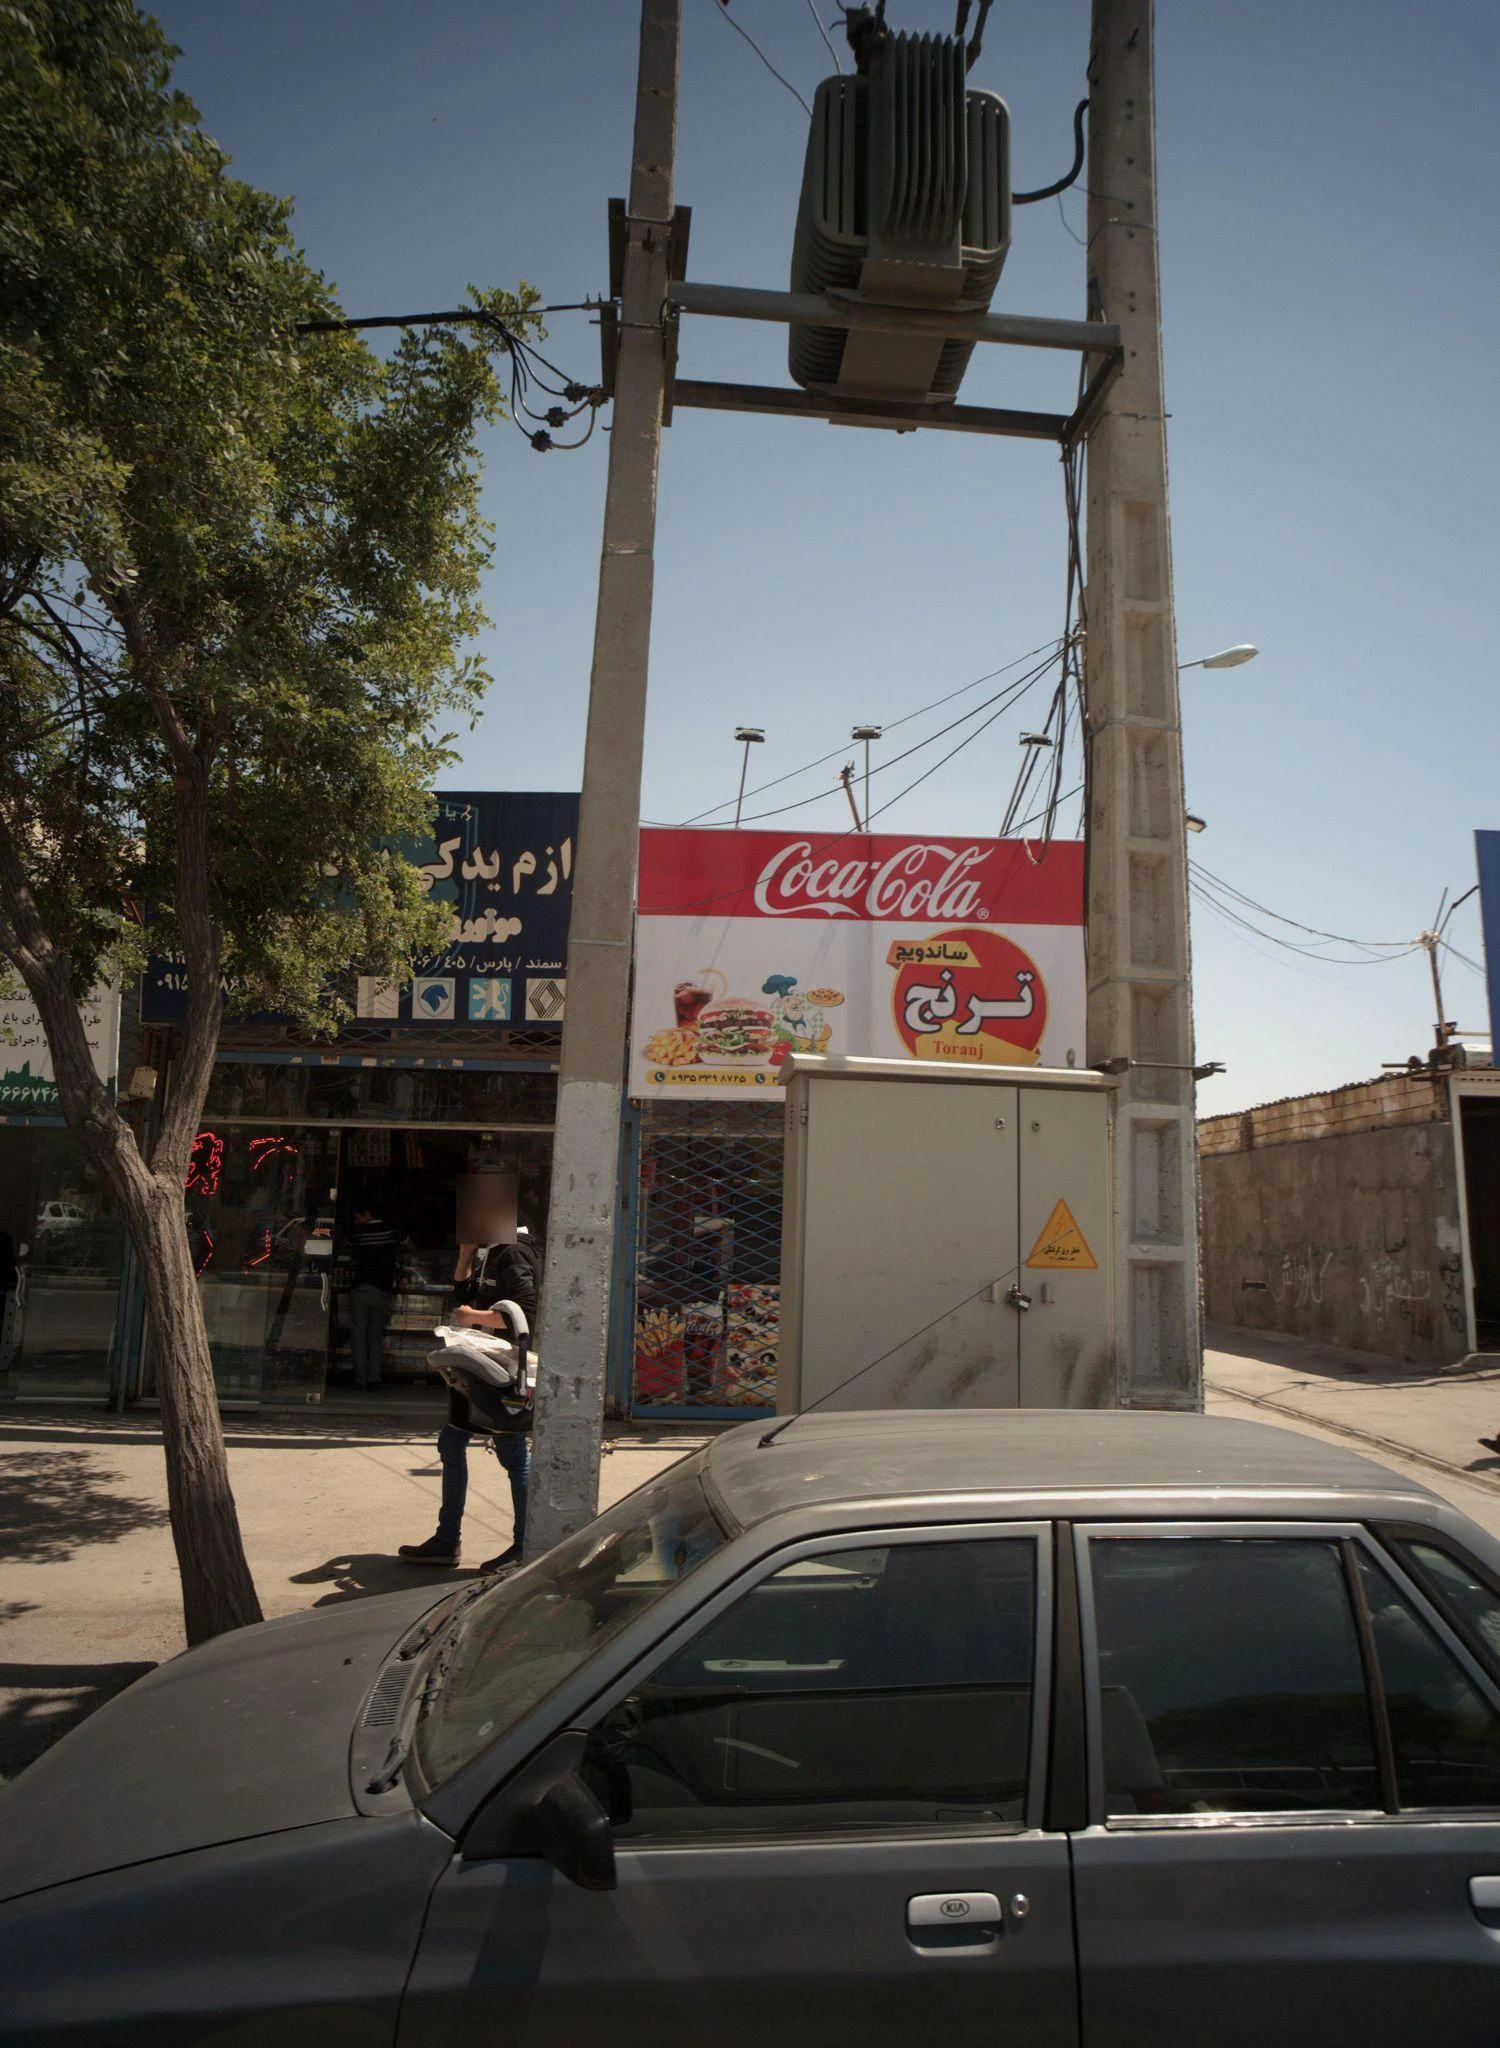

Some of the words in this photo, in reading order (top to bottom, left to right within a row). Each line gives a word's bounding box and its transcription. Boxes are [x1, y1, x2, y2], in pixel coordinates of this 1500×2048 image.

[754, 841, 995, 918] Coca-Cola
[895, 943, 968, 962] ساندویچ
[476, 957, 512, 973] پارس
[525, 958, 562, 969] سمند
[904, 968, 1035, 1034] ترنج
[3, 1012, 18, 1025] باغ
[8, 1035, 39, 1048] اجرای
[933, 1040, 984, 1060] Toranj
[0, 1086, 59, 1102] ۶۶۶۷۴۶
[946, 1902, 966, 1913] KIA
